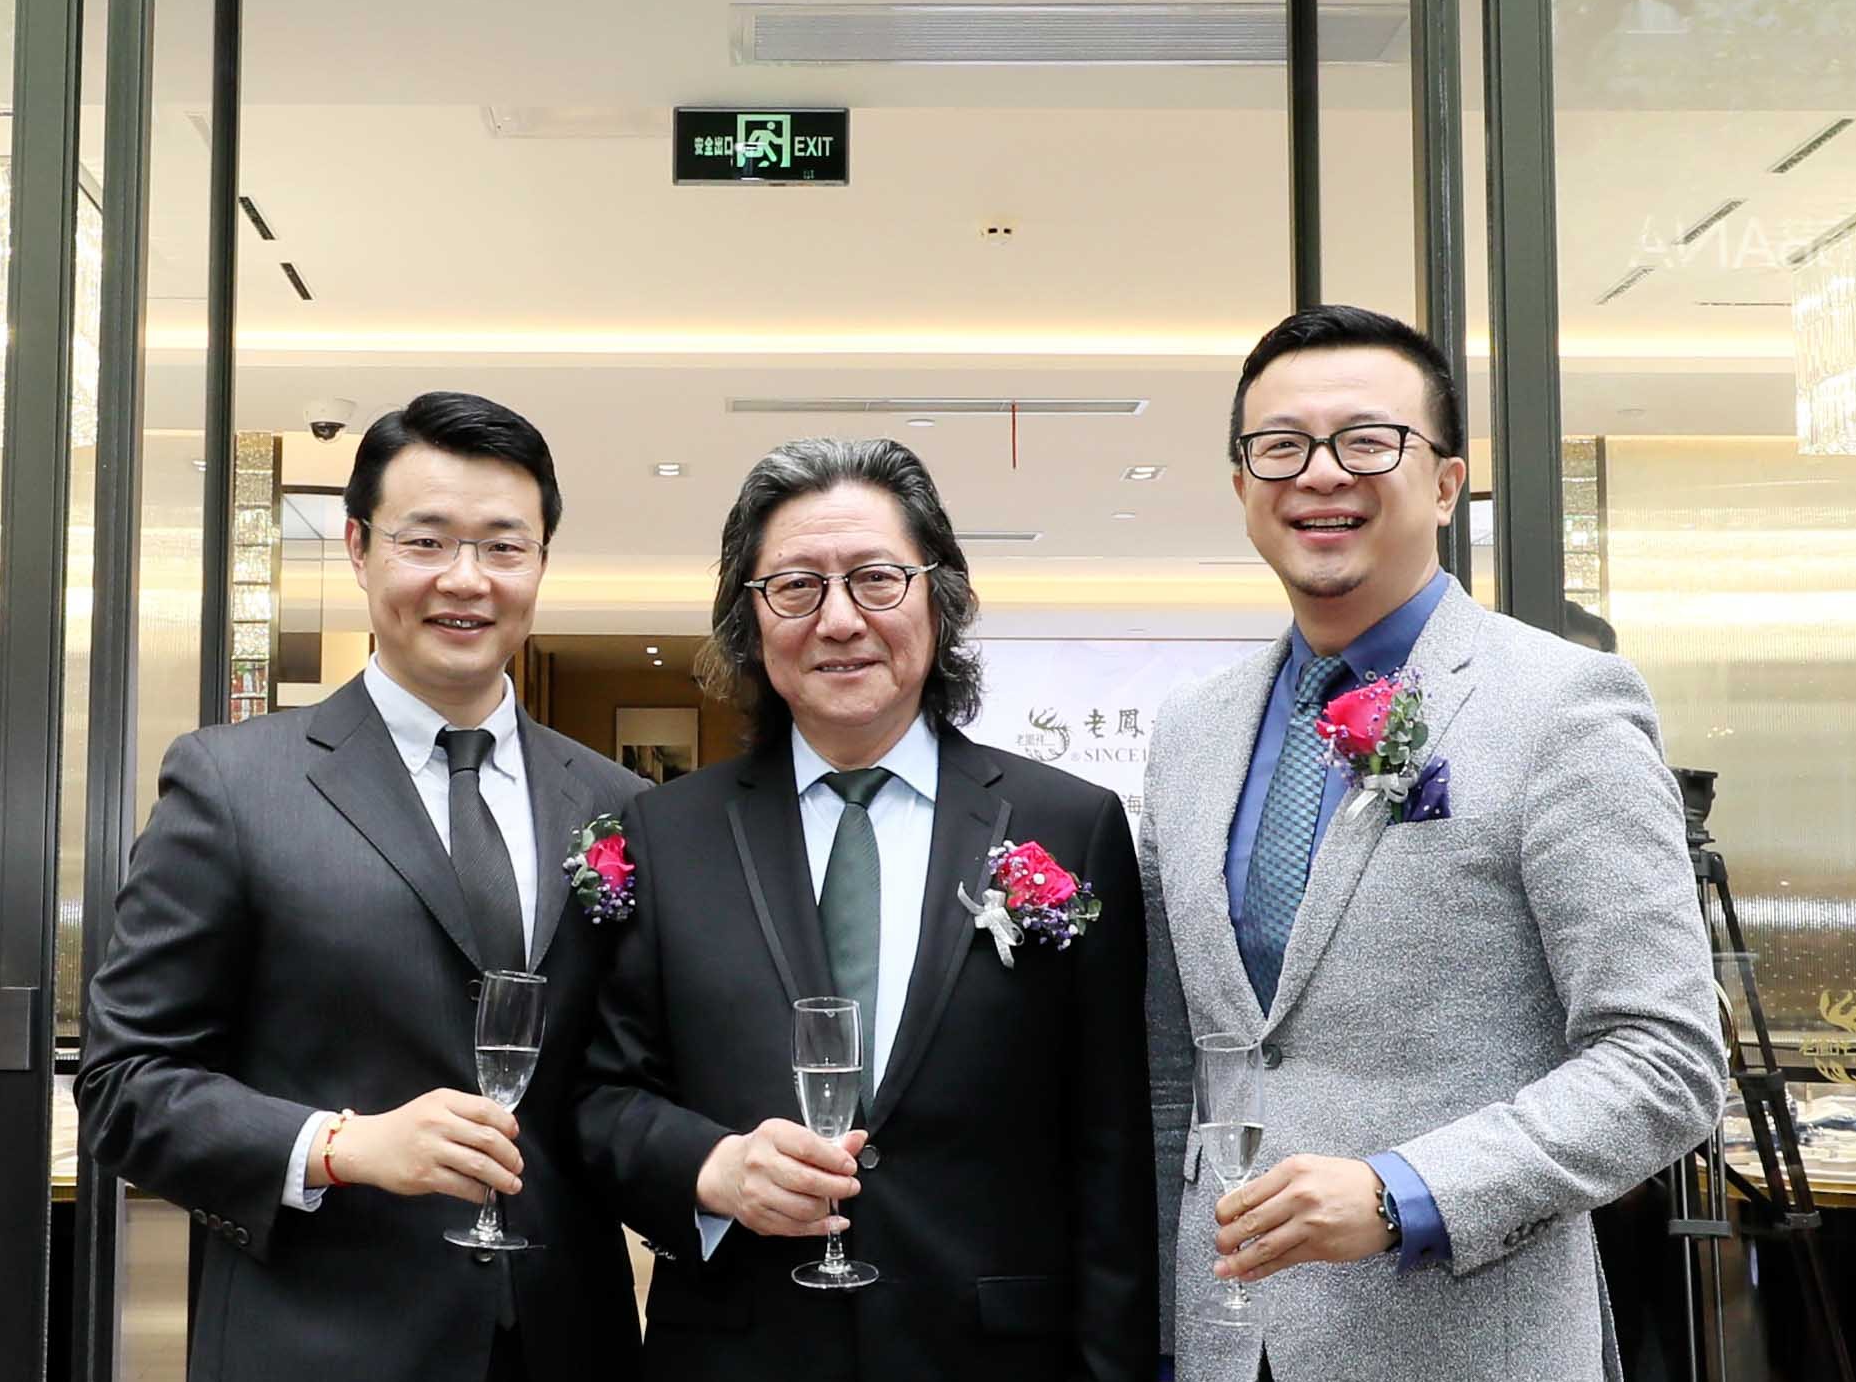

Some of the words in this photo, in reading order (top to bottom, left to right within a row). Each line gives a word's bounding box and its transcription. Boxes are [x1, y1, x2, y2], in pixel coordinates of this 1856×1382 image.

[694, 135, 734, 156] 安全出口
[794, 136, 835, 157] EXIT
[1083, 708, 1153, 739] 老鳳
